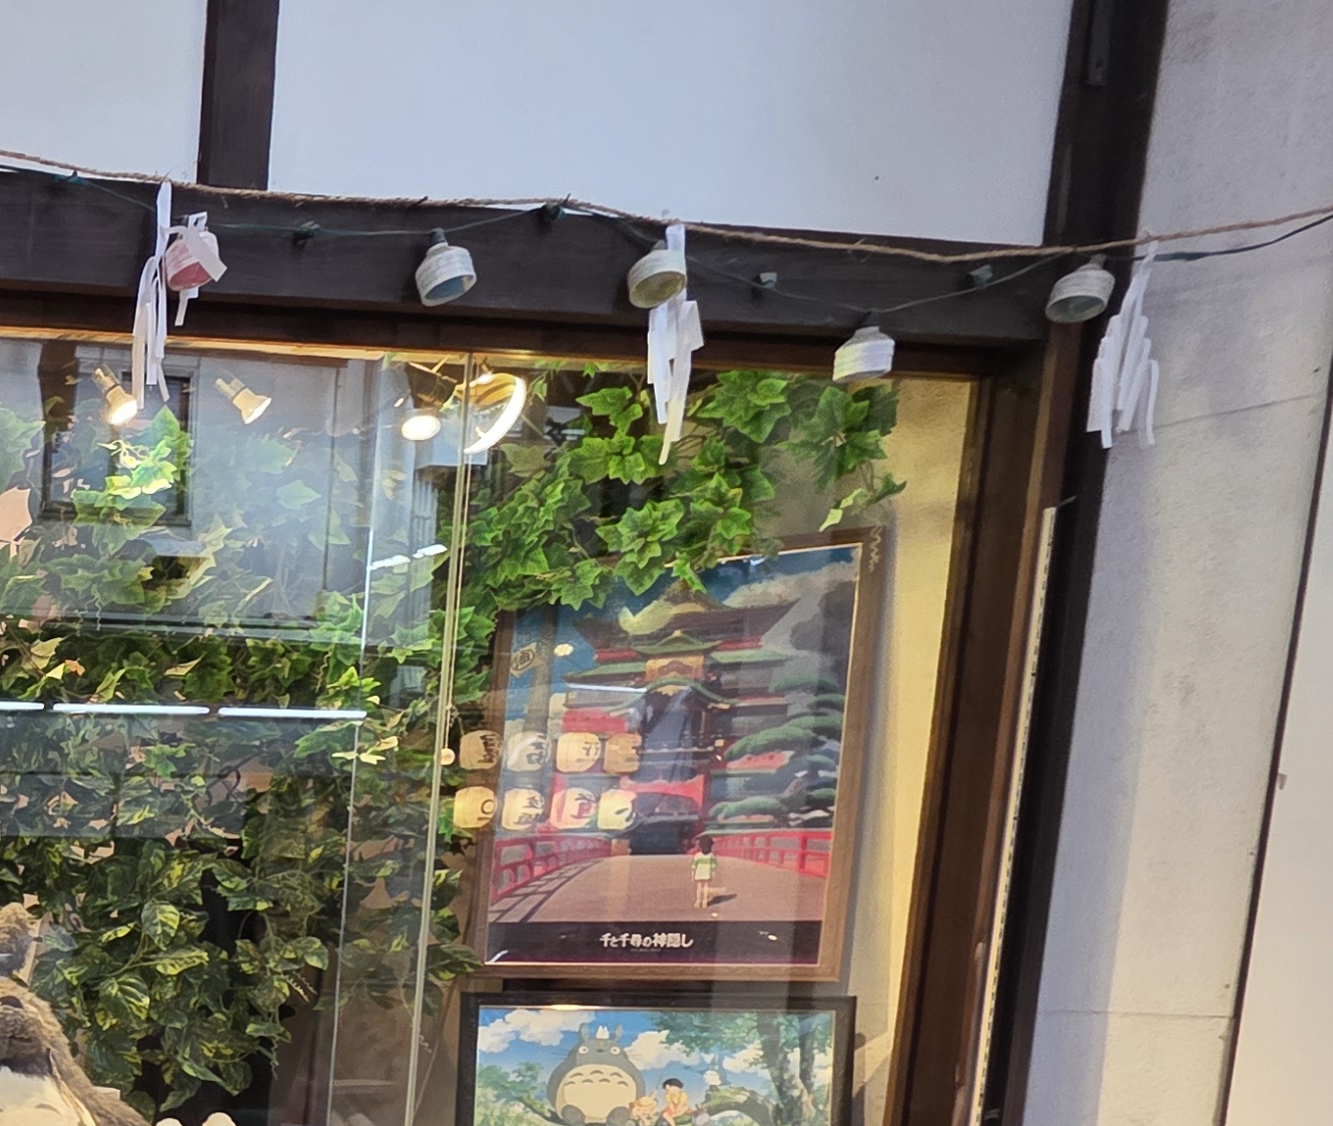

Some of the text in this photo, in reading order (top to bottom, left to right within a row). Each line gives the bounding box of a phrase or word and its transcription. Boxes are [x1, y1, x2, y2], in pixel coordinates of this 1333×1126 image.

[599, 932, 694, 948] 千と千尋の神隠し
